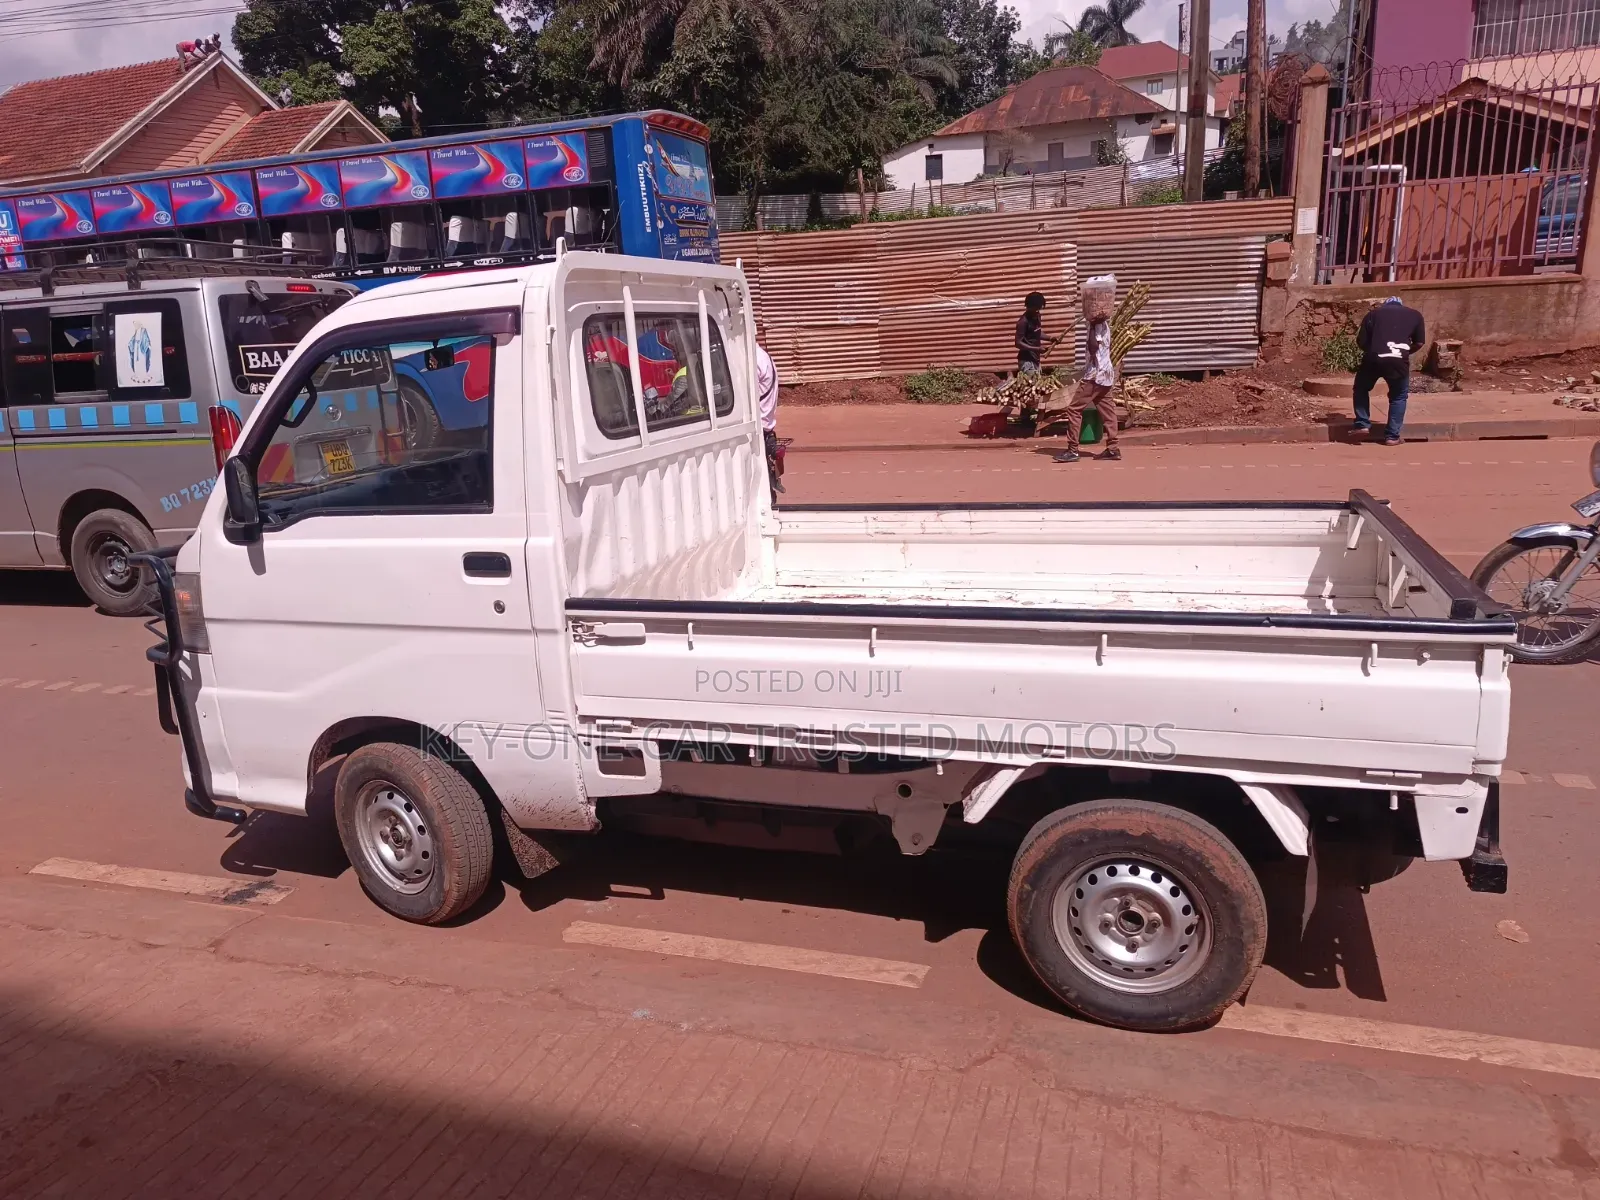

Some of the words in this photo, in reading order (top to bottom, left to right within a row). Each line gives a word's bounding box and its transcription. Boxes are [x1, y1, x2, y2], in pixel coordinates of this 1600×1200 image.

[437, 149, 453, 159] Travel
[260, 170, 274, 179] Travel
[176, 180, 190, 188] Travel
[398, 265, 422, 273] Twitter
